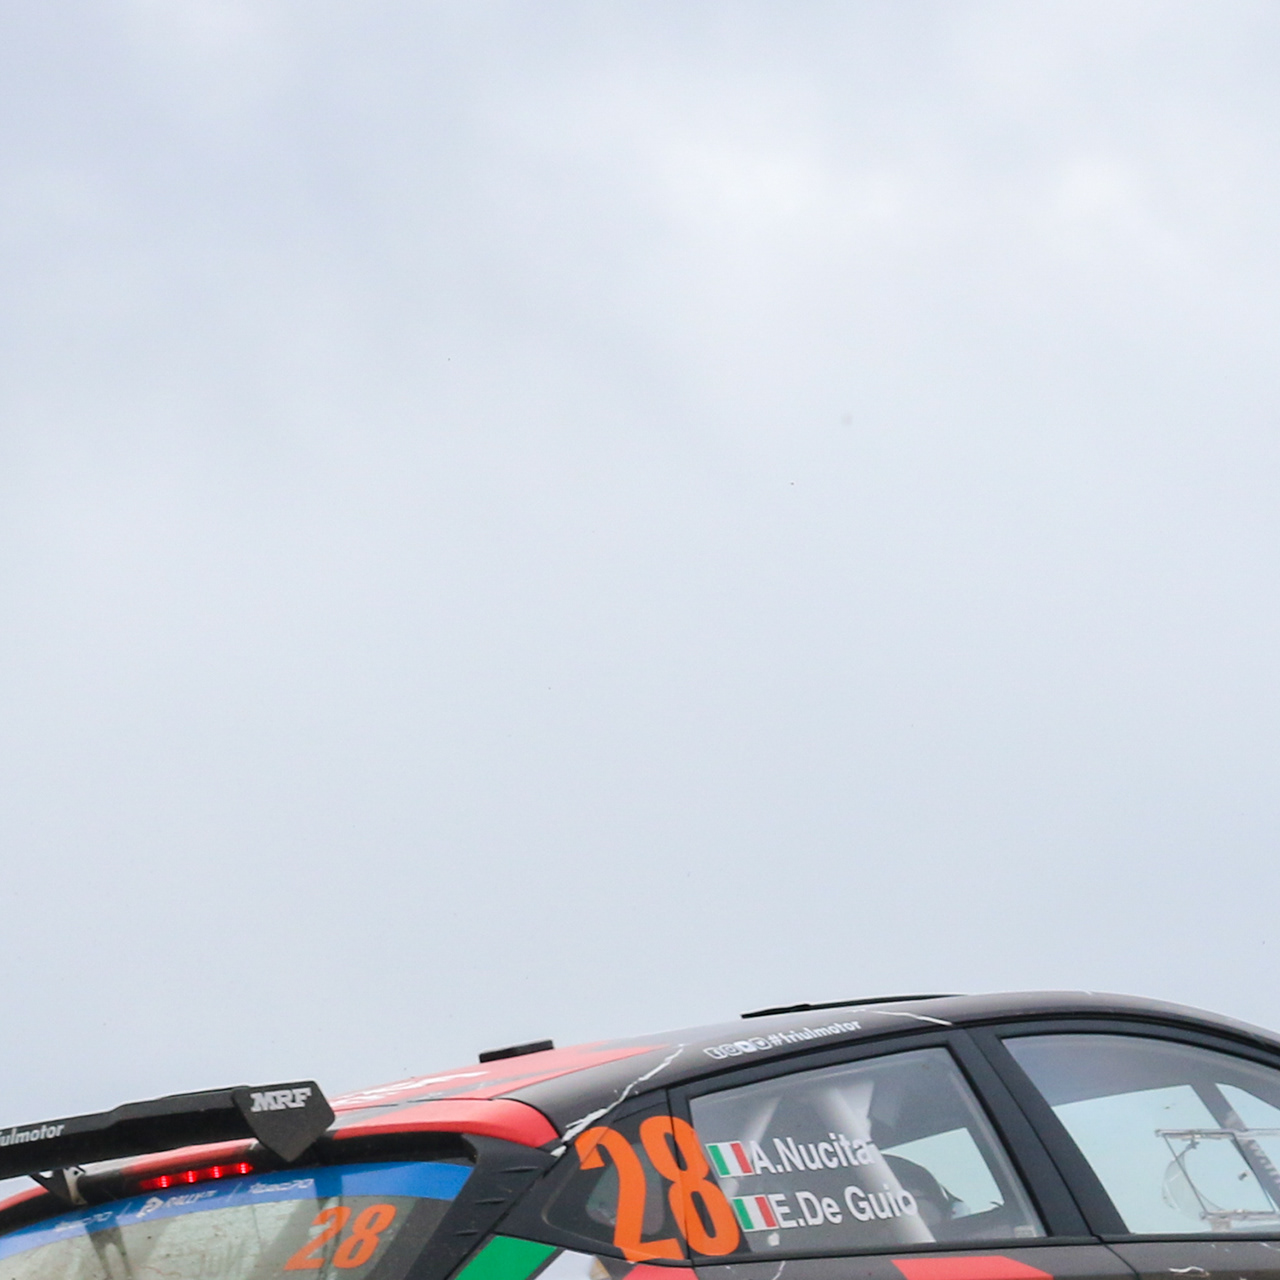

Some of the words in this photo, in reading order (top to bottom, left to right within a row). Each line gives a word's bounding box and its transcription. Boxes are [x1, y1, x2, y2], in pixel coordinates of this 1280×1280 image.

[250, 1087, 312, 1112] MRF
[750, 1132, 875, 1175] A.Nucita
[576, 1115, 741, 1263] 28
[767, 1191, 843, 1229] E.De
[844, 1184, 919, 1222] Guio
[283, 1203, 397, 1271] 28
